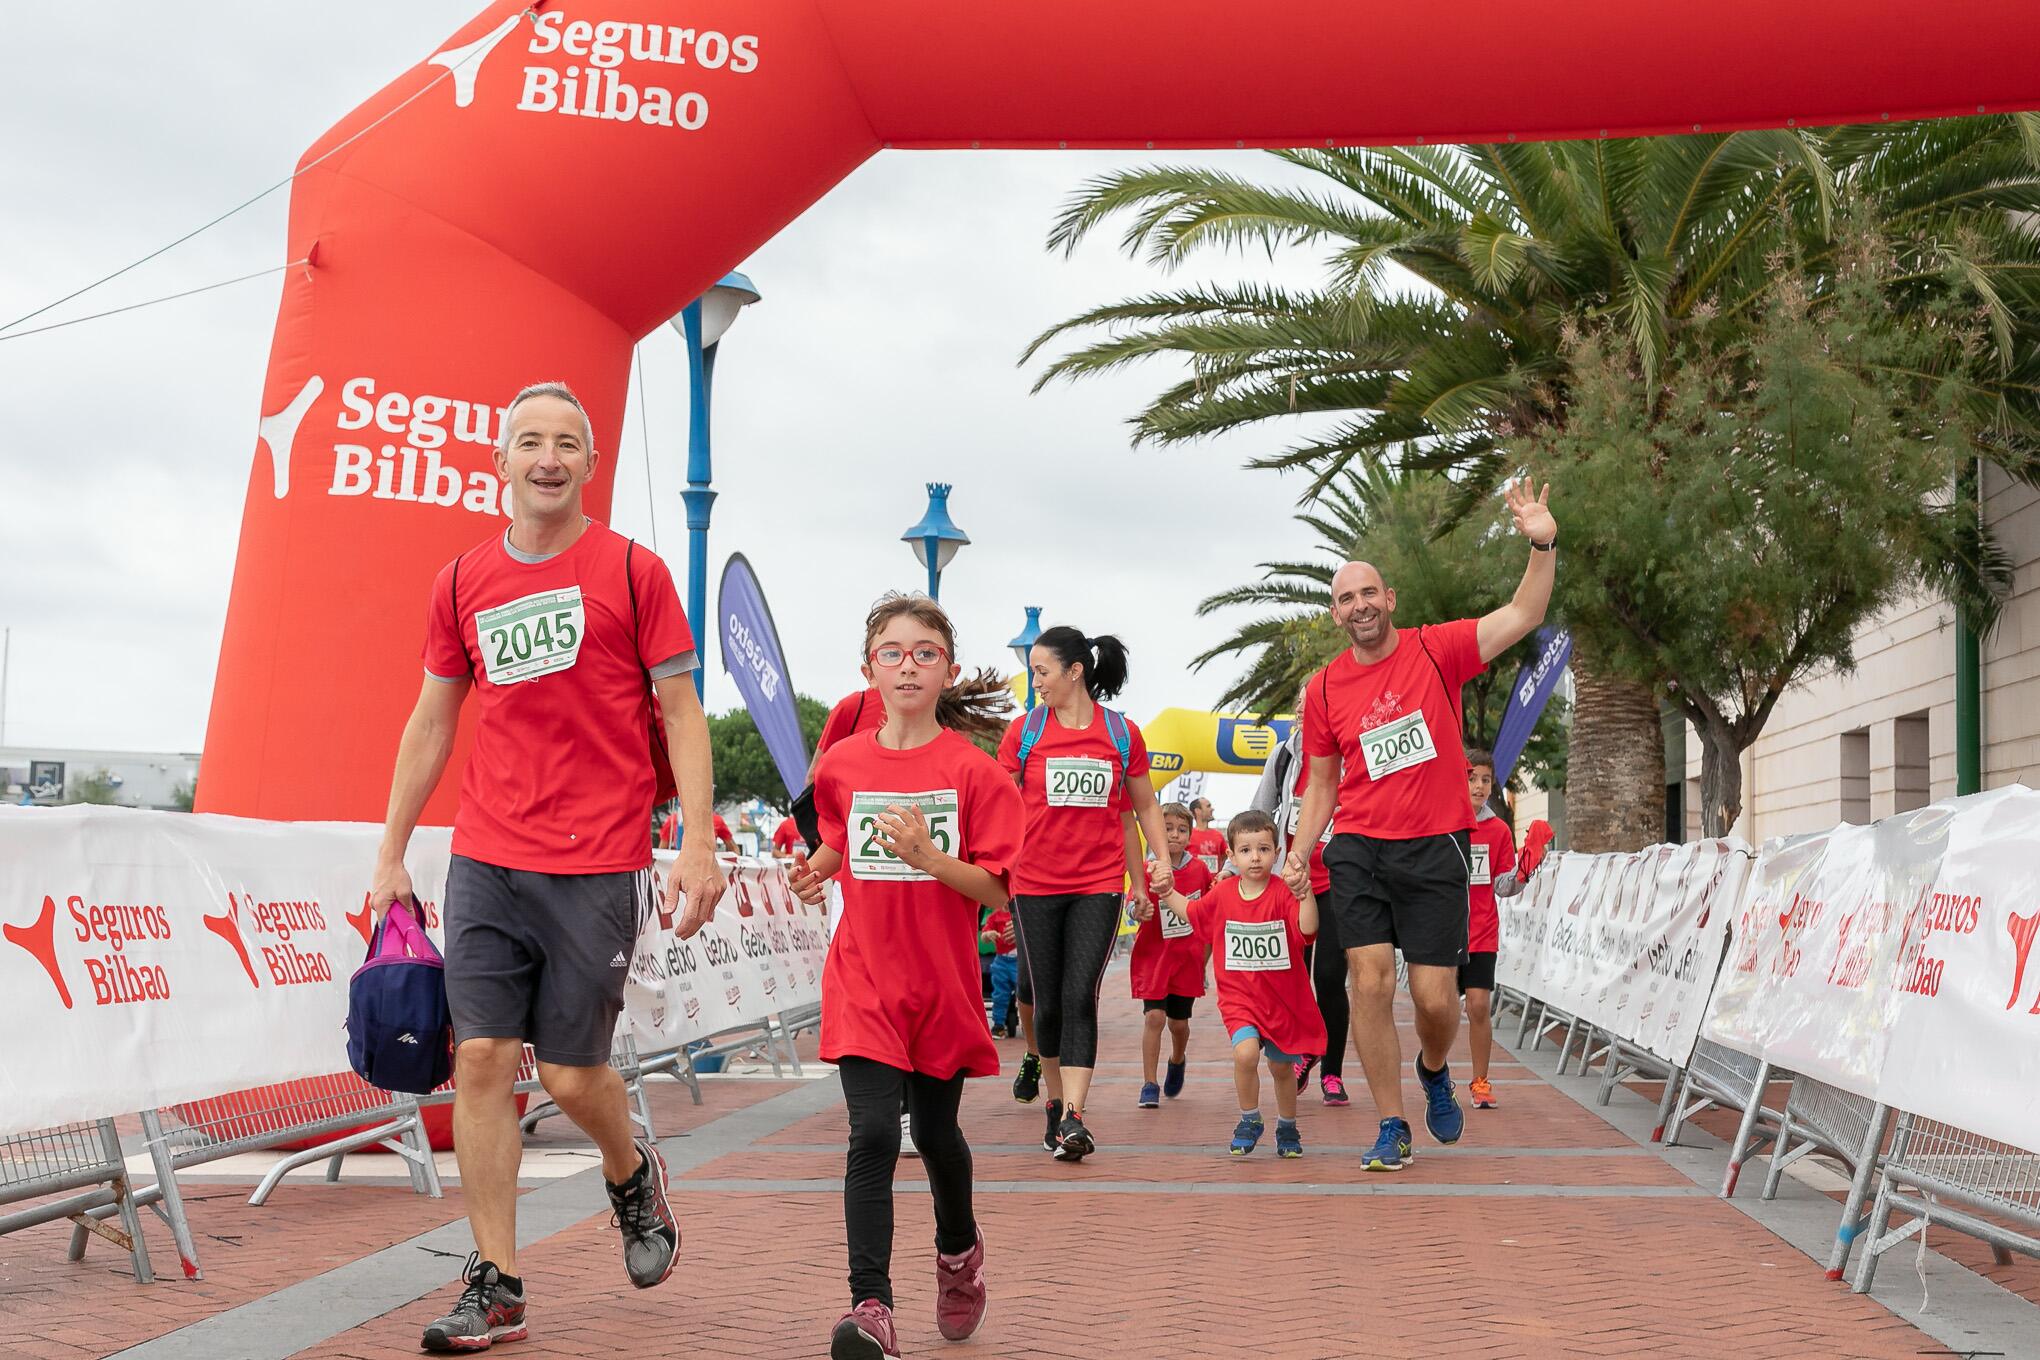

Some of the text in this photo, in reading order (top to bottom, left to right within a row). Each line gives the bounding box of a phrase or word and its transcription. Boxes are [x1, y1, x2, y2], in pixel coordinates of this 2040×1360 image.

[528, 10, 759, 74] Seguros
[516, 65, 709, 131] Bilbao
[490, 611, 578, 667] 2045
[1151, 754, 1181, 769] BM
[1371, 727, 1425, 766] 2060
[1053, 771, 1106, 795] 2060
[66, 895, 172, 951] Seguros
[243, 892, 327, 943] Seguros
[1919, 886, 1982, 940] guros
[261, 942, 333, 986] Bilbao
[1231, 935, 1281, 959] 2060
[84, 953, 171, 1006] Bilbao
